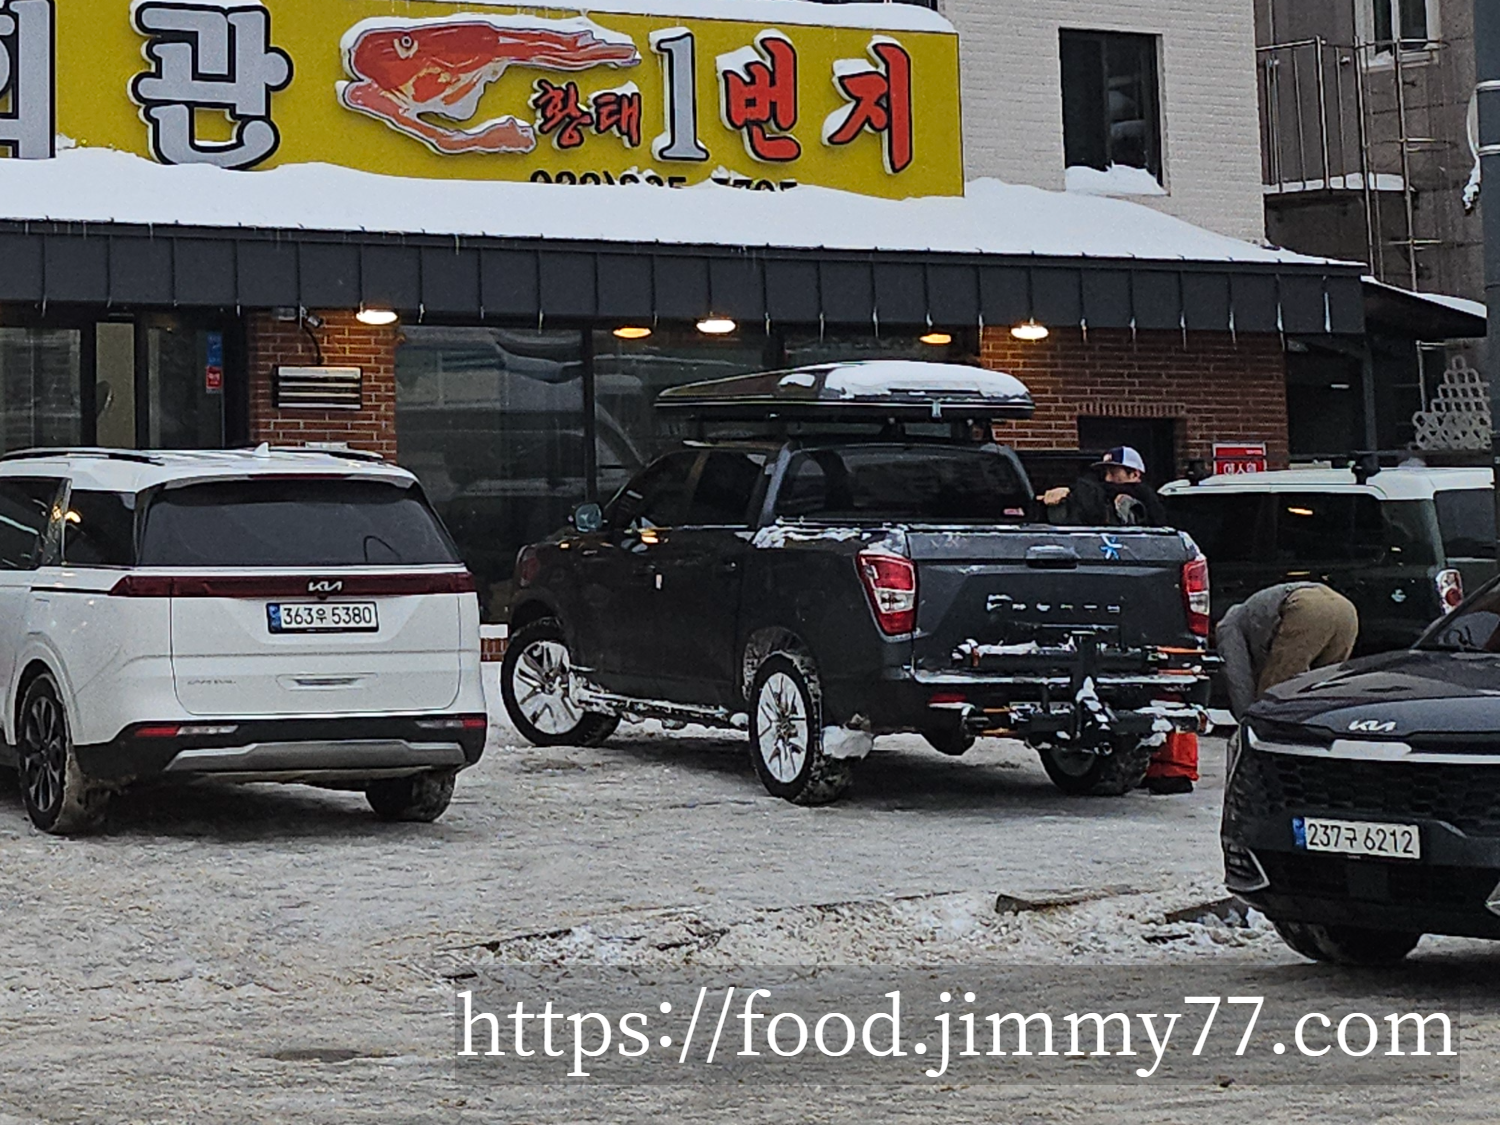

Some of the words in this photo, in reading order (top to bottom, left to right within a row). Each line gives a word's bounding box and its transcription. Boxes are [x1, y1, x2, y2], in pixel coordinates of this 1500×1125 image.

[530, 78, 642, 149] 황태
[652, 28, 913, 175] 1번지
[283, 606, 327, 626] 363우
[331, 606, 373, 625] 5380
[1307, 822, 1358, 850] 237구
[1363, 826, 1415, 855] 6212
